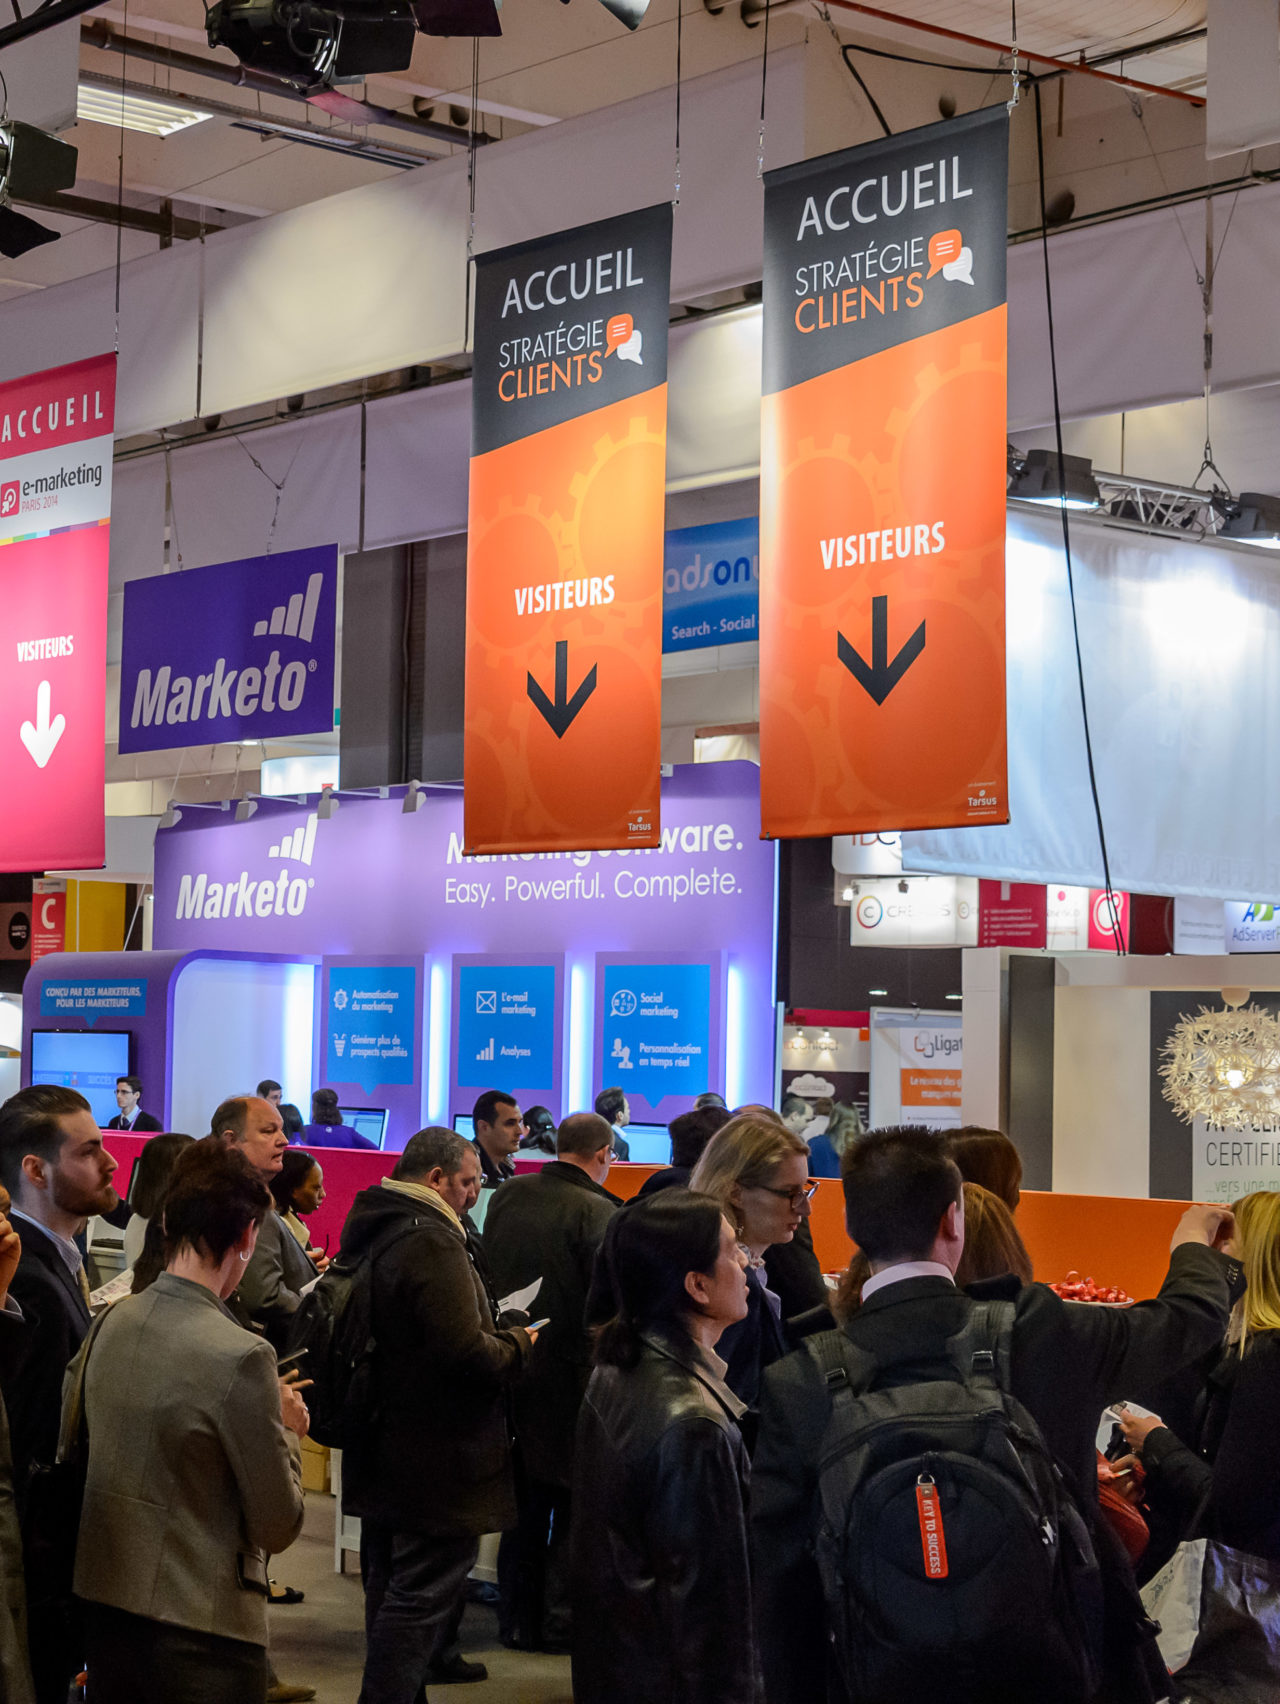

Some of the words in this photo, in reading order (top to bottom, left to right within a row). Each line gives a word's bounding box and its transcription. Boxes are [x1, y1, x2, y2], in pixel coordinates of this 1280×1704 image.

[797, 156, 973, 241] ACCUEIL
[795, 237, 923, 296] STRATÉGIE
[501, 248, 643, 318] ACCUEIL
[795, 272, 924, 333] CLIENTS
[499, 319, 603, 368] STRATÉGIE
[498, 351, 602, 402] CLIENTS
[1, 391, 103, 443] ACCUEIL
[22, 463, 102, 496] e-marketing
[21, 499, 41, 513] PARIS
[43, 495, 58, 509] 2014
[820, 521, 945, 570] VISITEURS
[515, 575, 615, 616] VISITEURS
[672, 621, 710, 640] Search
[720, 614, 755, 632] Social
[17, 635, 73, 662] VISITEURS
[968, 797, 997, 807] Tarsus
[627, 822, 652, 831] Tarsus
[445, 878, 495, 908] Easy.
[505, 872, 605, 901] Powerful.
[615, 867, 742, 903] Complete.
[41, 898, 56, 929] C
[46, 987, 68, 998] CONÇU
[70, 987, 82, 996] PAR
[84, 987, 96, 996] DES
[640, 992, 663, 1003] Social
[56, 999, 74, 1007] POUR
[75, 999, 85, 1007] LES
[87, 998, 129, 1007] MARKETEURS
[361, 1000, 393, 1013] marketing
[501, 1004, 536, 1017] marketing
[640, 1005, 678, 1019] marketing
[377, 1034, 391, 1047] plus
[392, 1034, 400, 1045] de
[639, 1043, 701, 1054] Personnalisation
[500, 1045, 531, 1059] Analyses
[650, 1057, 673, 1069] temps
[675, 1056, 690, 1067] réel
[1243, 1180, 1264, 1193] une
[922, 1500, 935, 1517] KEY
[925, 1519, 936, 1531] TO
[927, 1533, 941, 1574] SUCCESS
